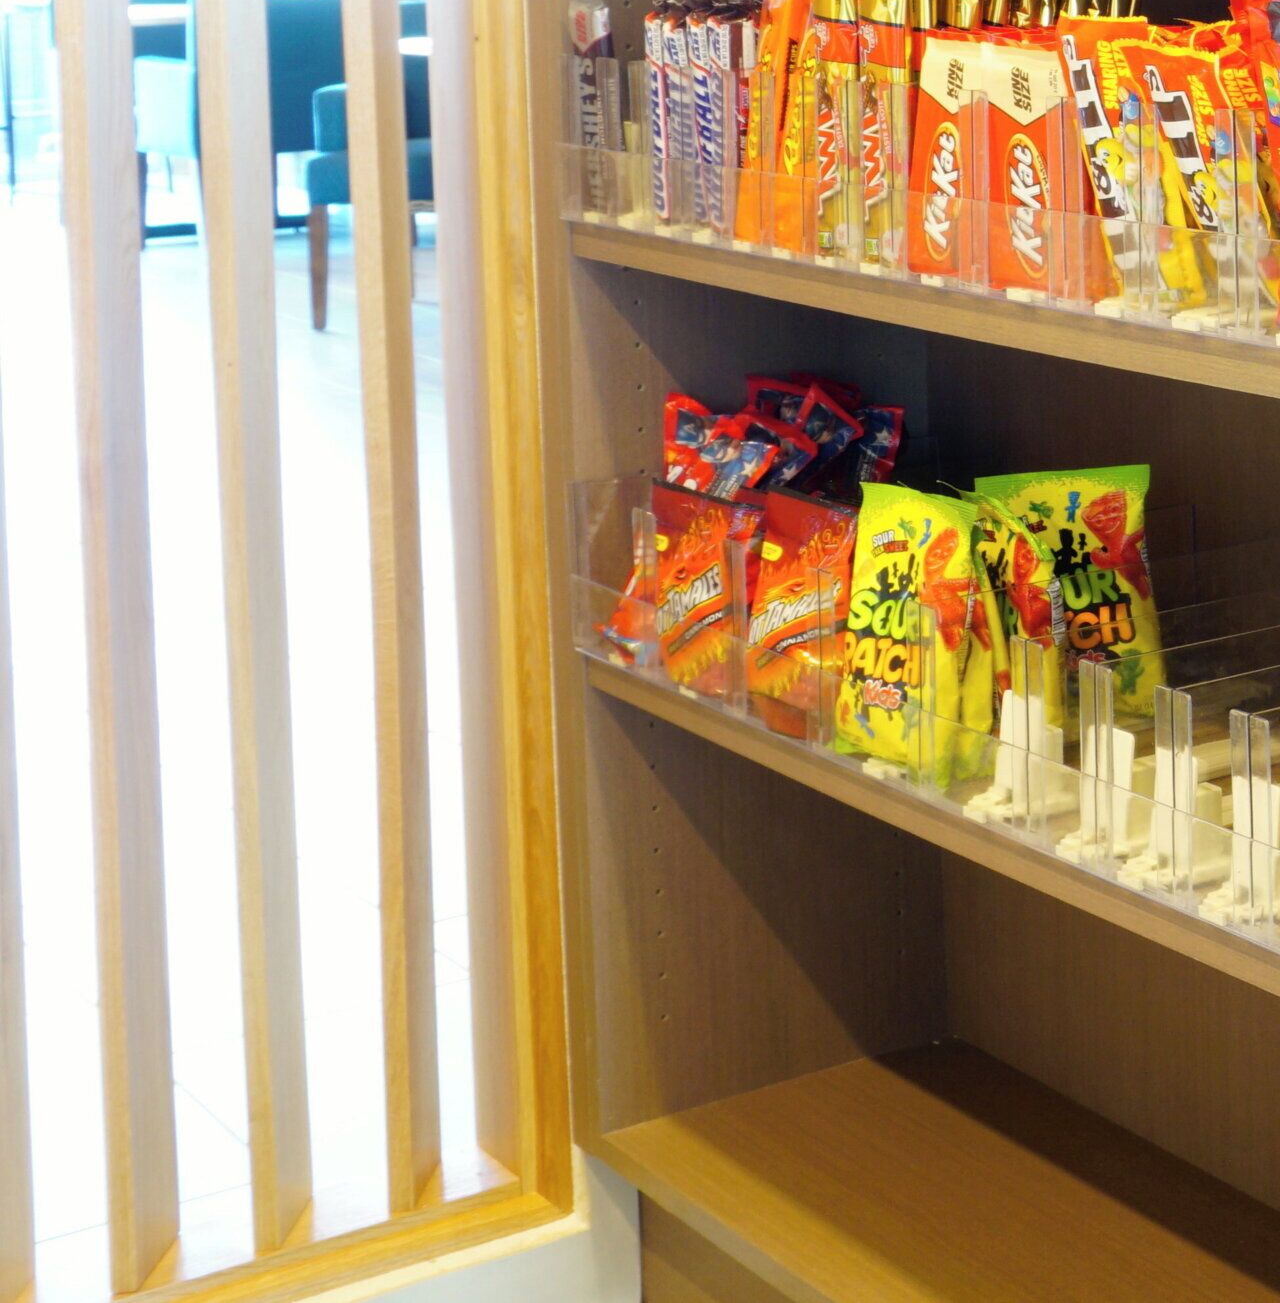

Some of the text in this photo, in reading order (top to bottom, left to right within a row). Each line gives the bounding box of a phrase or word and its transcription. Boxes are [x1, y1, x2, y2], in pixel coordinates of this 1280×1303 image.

[1011, 67, 1032, 113] KING SIZE
[1096, 40, 1119, 109] SHARING
[1236, 68, 1262, 103] SIZE
[872, 530, 896, 546] SOUR
[668, 564, 723, 622] TAMALES
[1061, 568, 1119, 610] UR
[847, 588, 931, 641] SOUR
[841, 632, 920, 685] PATCH
